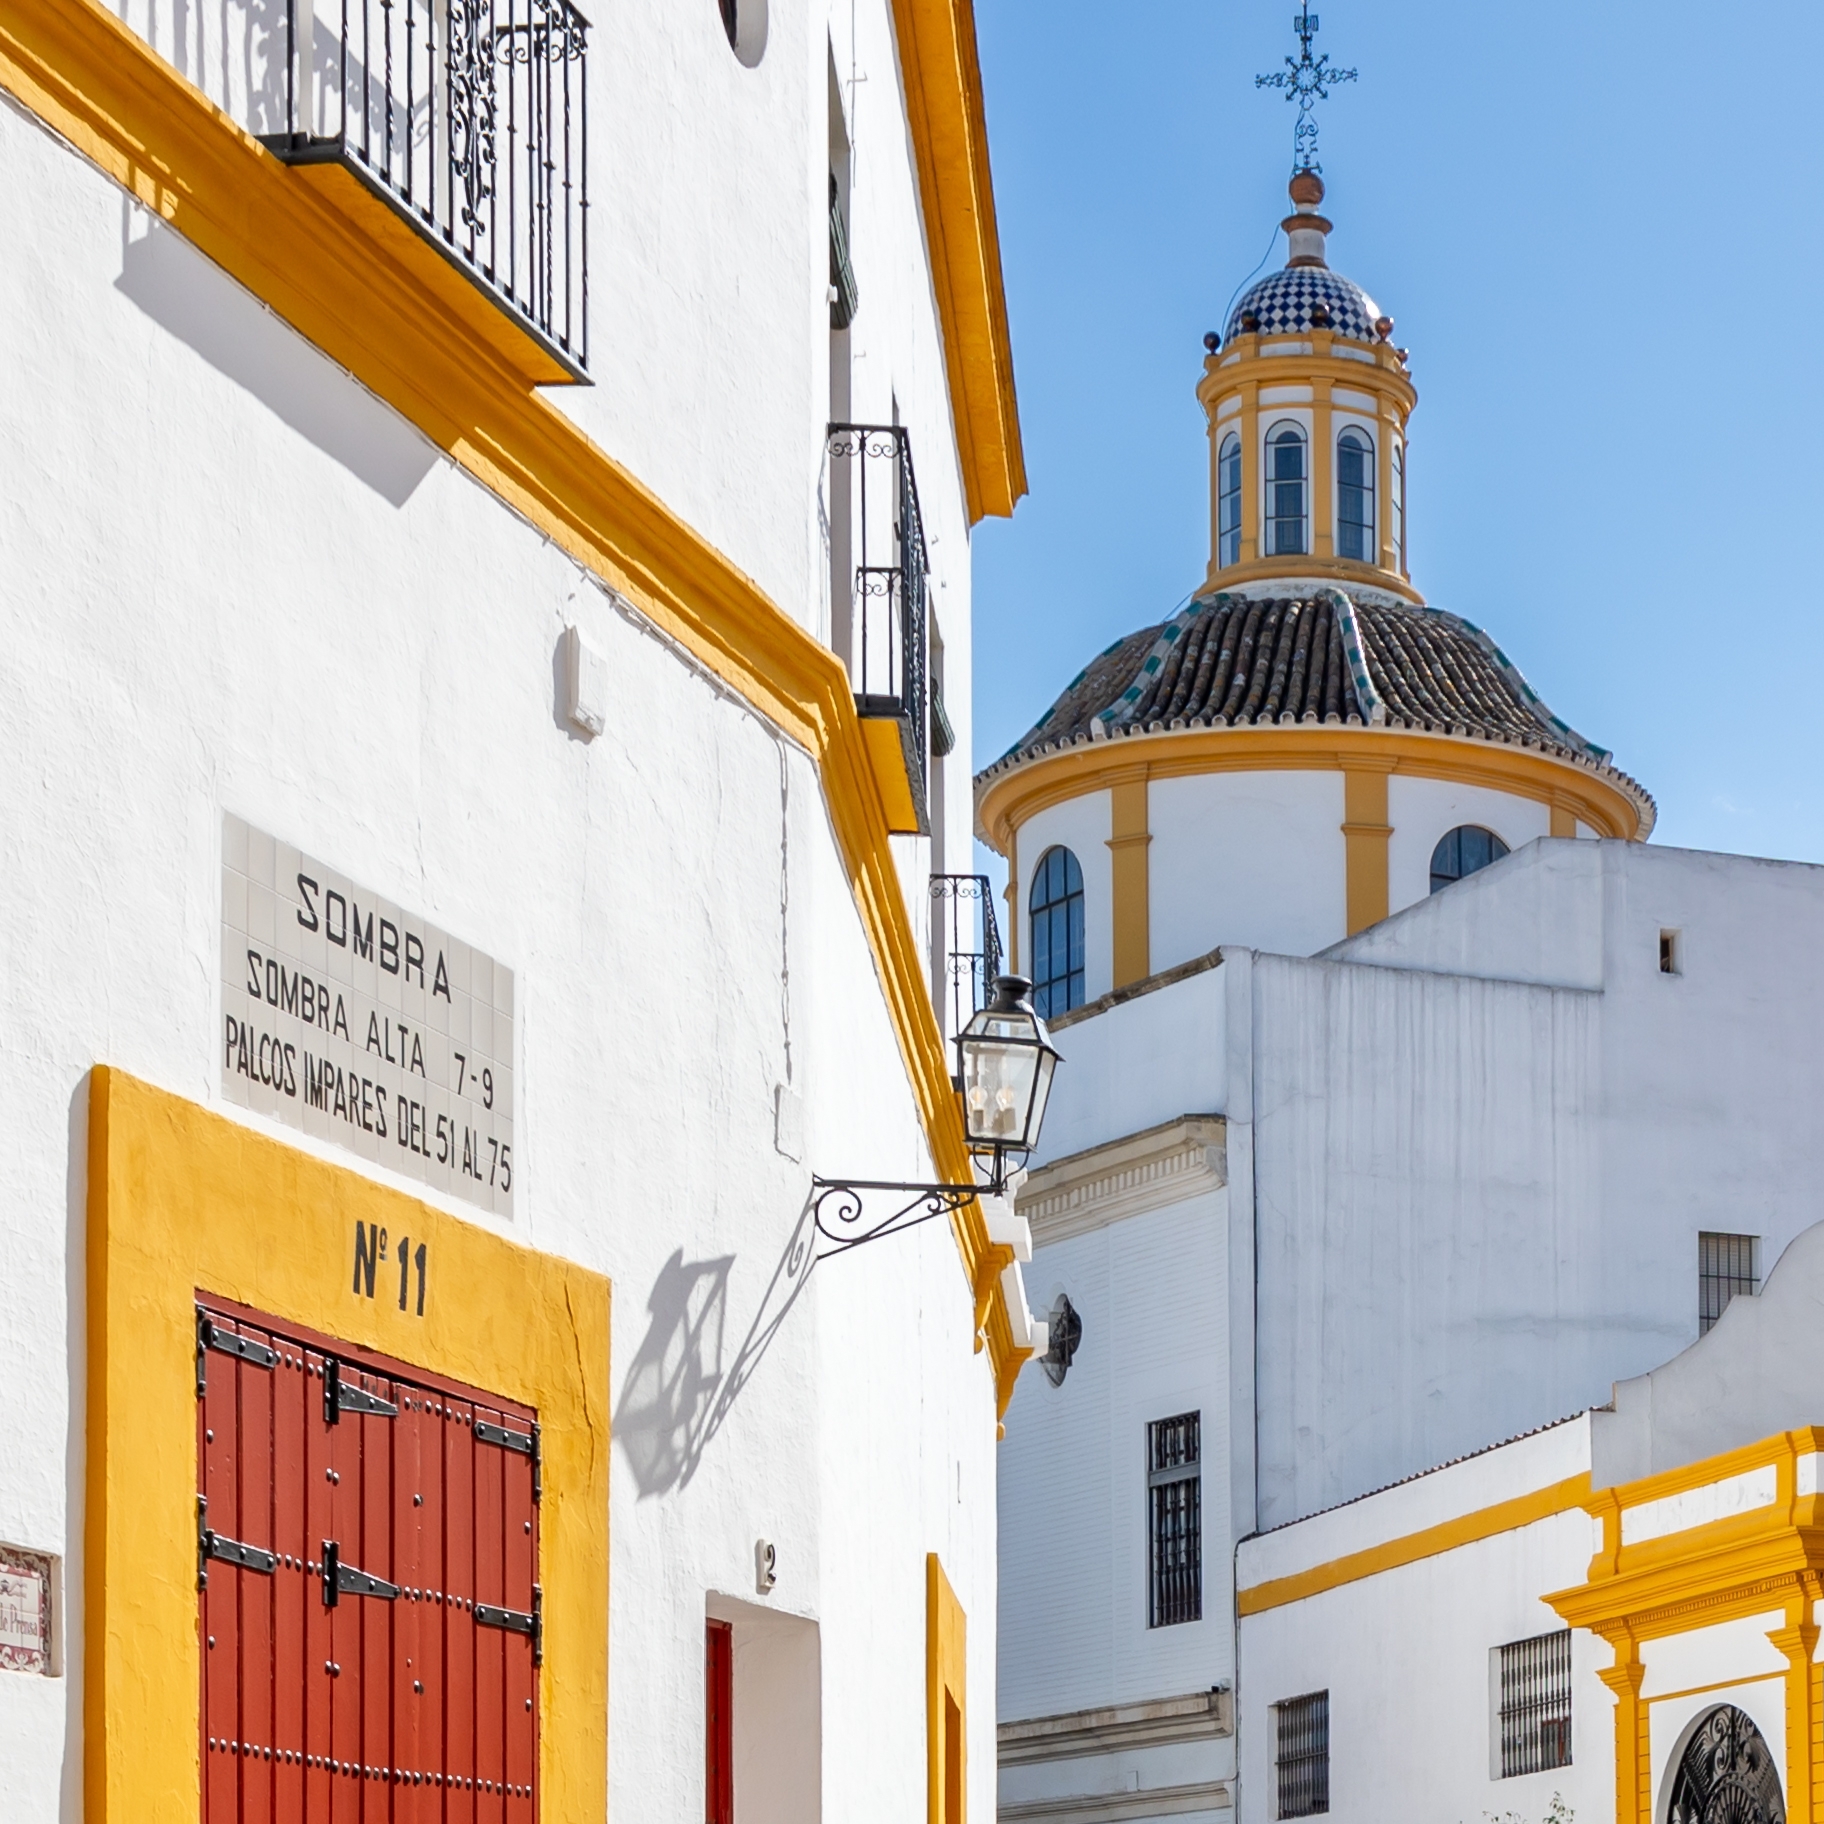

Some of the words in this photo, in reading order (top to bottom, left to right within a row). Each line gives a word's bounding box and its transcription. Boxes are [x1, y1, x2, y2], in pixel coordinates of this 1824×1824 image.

[297, 873, 452, 1004] SOMBRA
[247, 949, 350, 1042] SOMBRA
[366, 1010, 426, 1079] ALTA
[454, 1052, 494, 1110] 7-9
[226, 1014, 297, 1098] PALCOS
[304, 1051, 387, 1138] IMPARES
[397, 1094, 431, 1158] DEL
[436, 1113, 455, 1169] 51
[462, 1126, 483, 1181] AL
[487, 1137, 511, 1193] 75
[397, 1236, 426, 1317] 11
